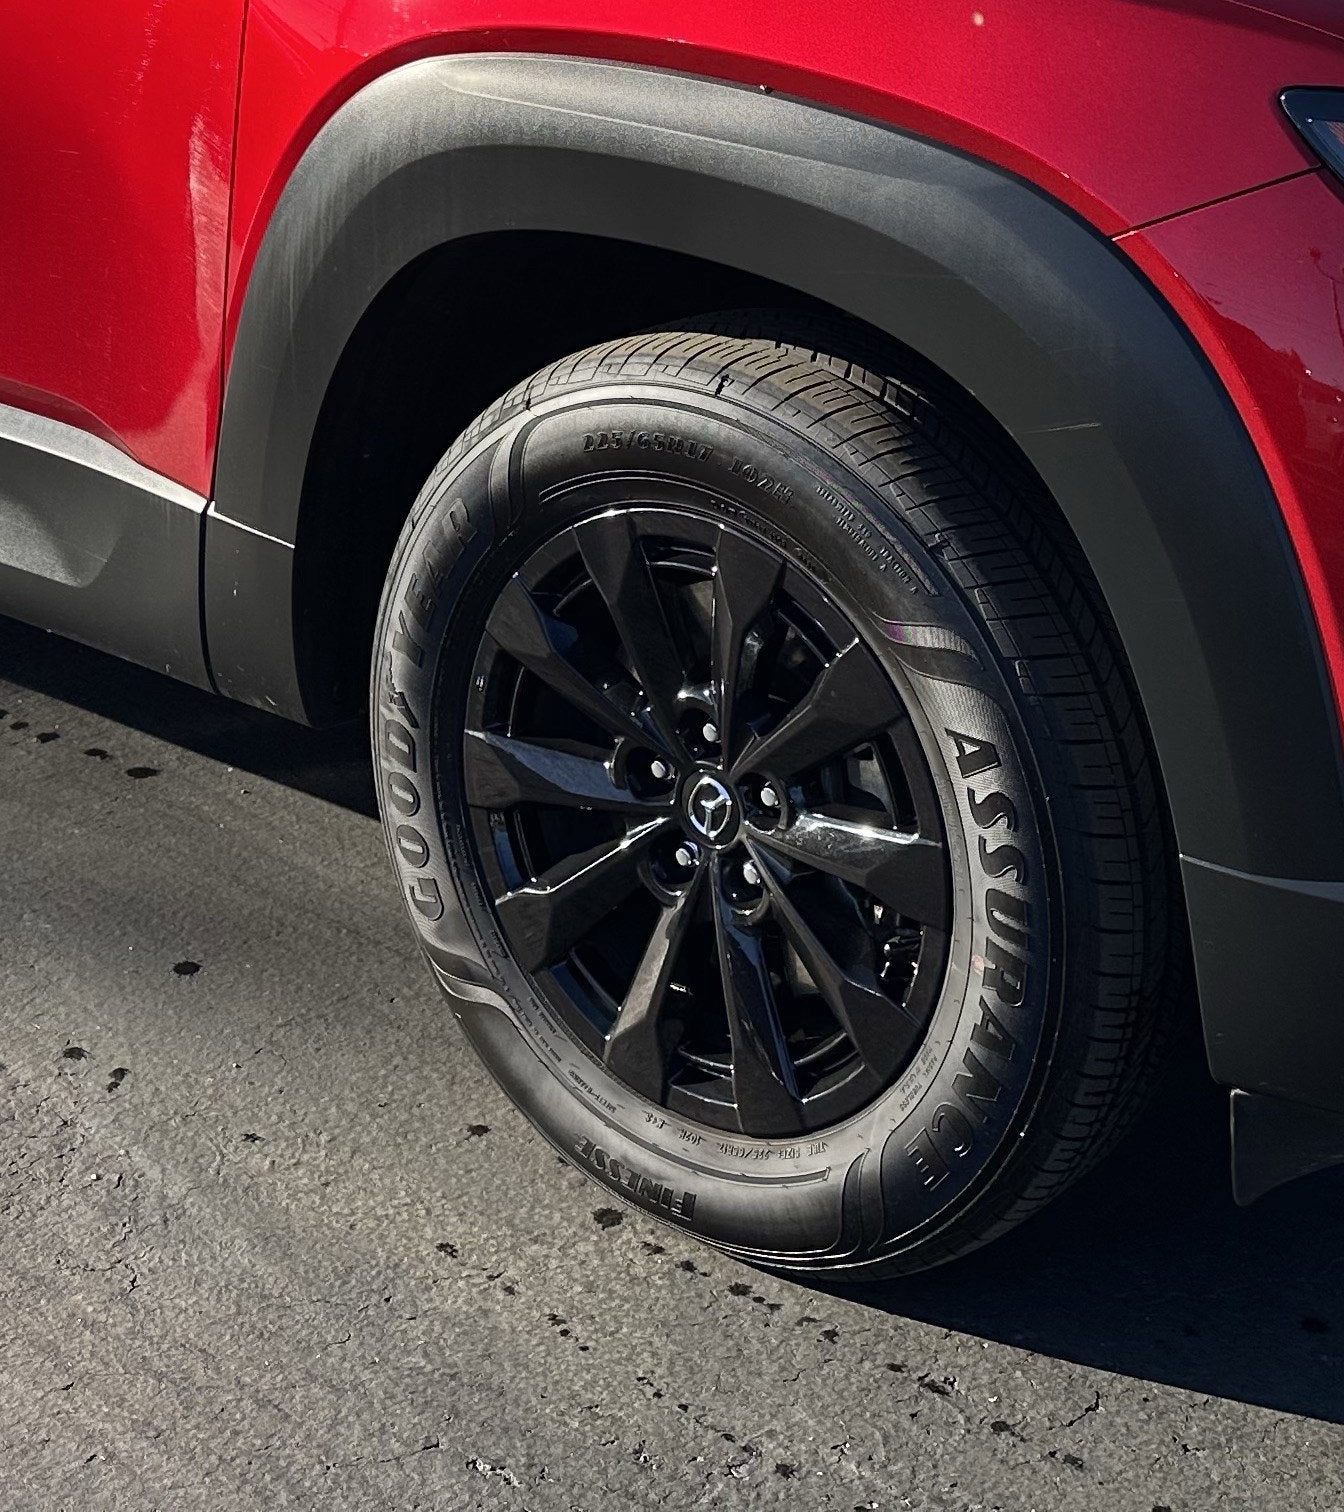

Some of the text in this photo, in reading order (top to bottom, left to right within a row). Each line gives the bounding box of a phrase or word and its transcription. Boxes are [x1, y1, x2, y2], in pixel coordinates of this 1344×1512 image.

[384, 496, 479, 921] GOODYEAR
[903, 727, 1031, 1191] ASSURANCE
[573, 1135, 698, 1221] FINESSE
